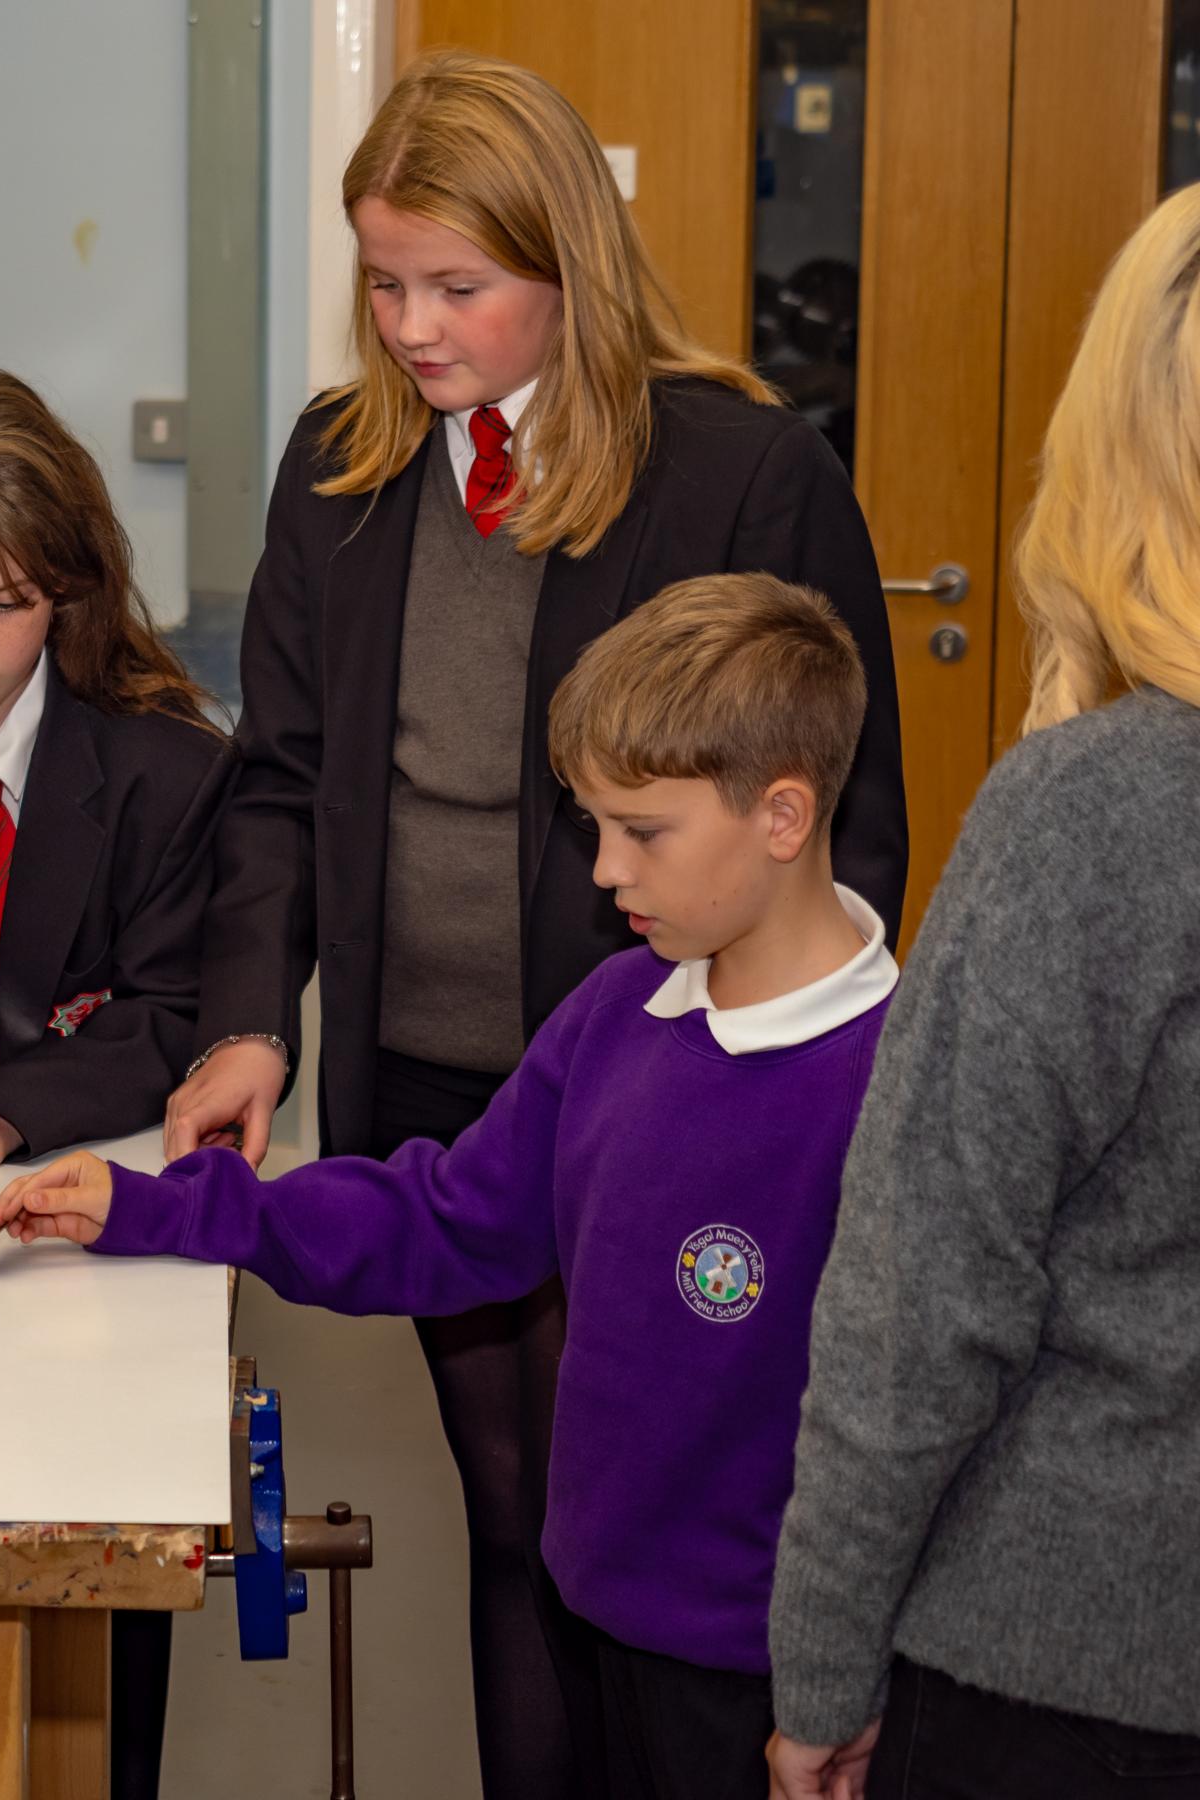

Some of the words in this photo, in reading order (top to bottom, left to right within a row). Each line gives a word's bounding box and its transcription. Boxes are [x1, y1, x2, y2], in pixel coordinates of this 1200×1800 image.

[687, 1229, 714, 1252] Ysgol
[716, 1229, 745, 1248] Maes
[741, 1243, 752, 1254] y
[747, 1250, 763, 1280] Felin
[681, 1270, 695, 1293] Mill
[688, 1291, 715, 1316] Field
[716, 1297, 750, 1318] School
